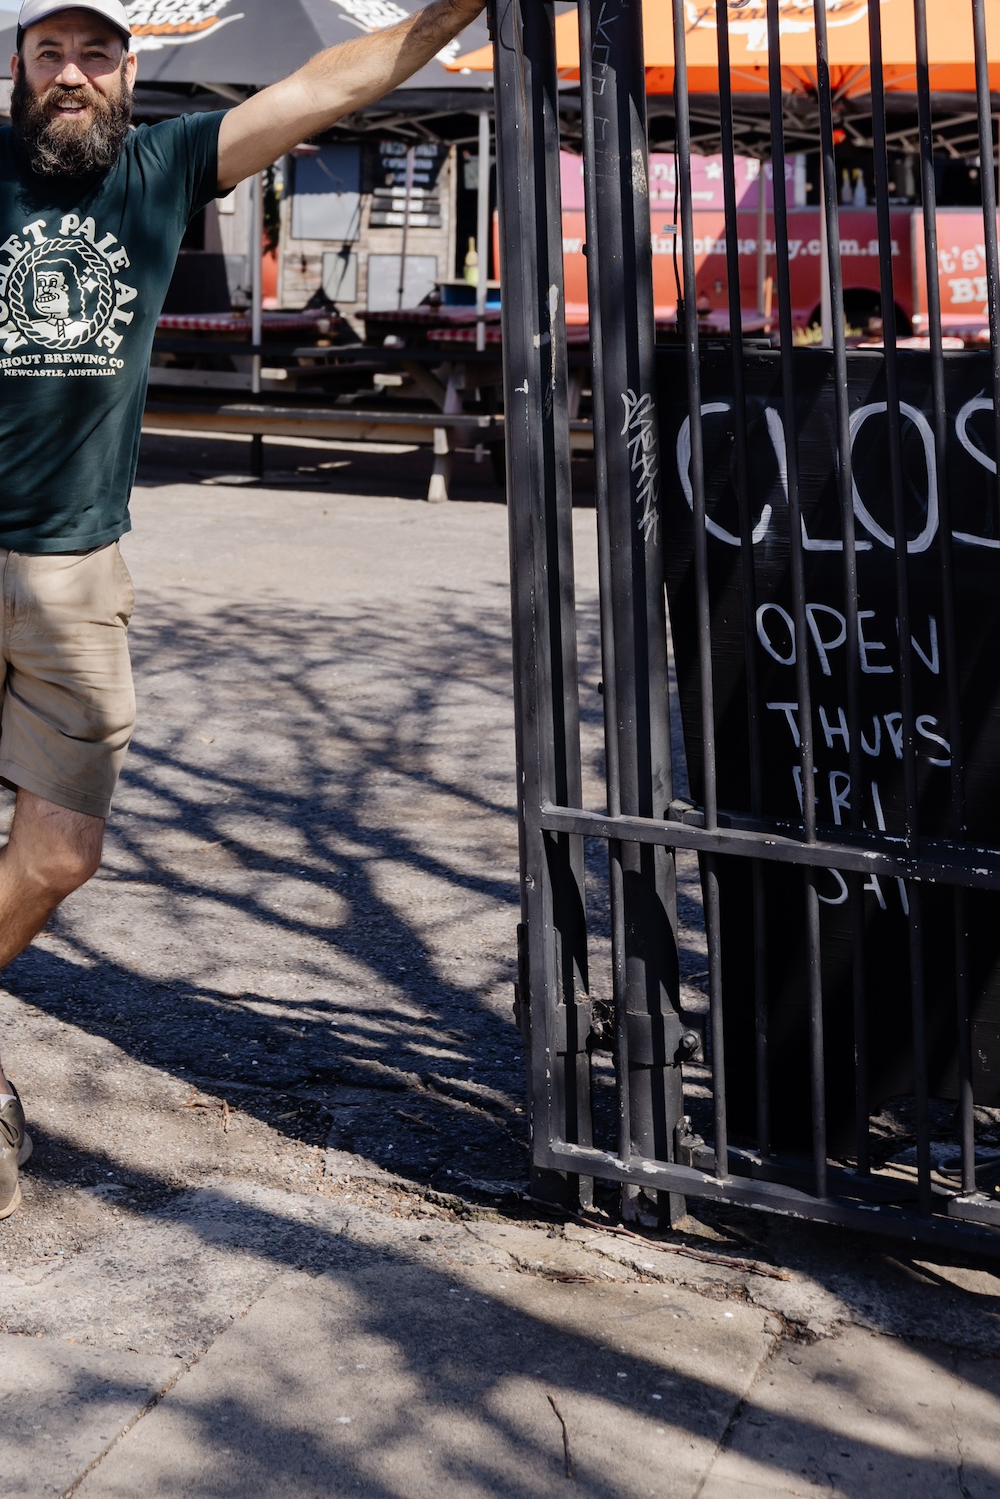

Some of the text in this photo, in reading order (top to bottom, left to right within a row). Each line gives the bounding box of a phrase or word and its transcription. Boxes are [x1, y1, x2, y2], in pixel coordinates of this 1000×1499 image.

[126, 10, 218, 26] AUCY
[938, 246, 980, 273] t's
[59, 214, 130, 273] PALE
[95, 279, 138, 354] ALE
[44, 353, 107, 367] BREWING
[109, 357, 124, 369] CO
[4, 367, 116, 378] NEWCASTLE, AUSTRALIA
[755, 602, 940, 676] OPEN
